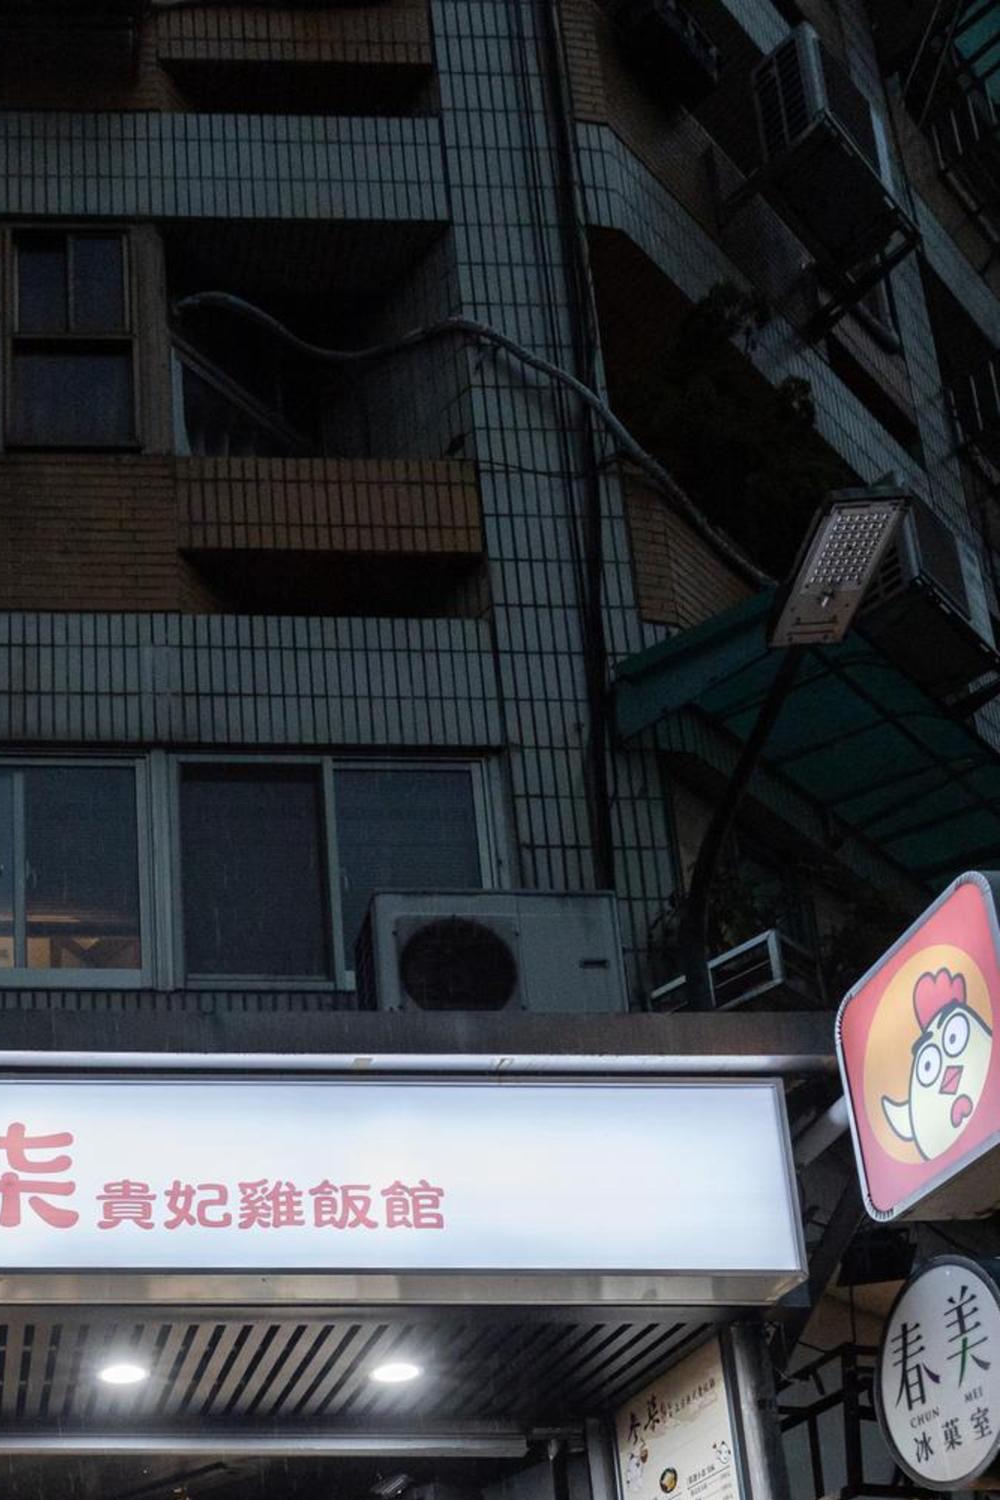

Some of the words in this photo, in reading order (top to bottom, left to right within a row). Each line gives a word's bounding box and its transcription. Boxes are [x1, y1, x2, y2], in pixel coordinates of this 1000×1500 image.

[96, 1178, 445, 1230] 貴妃雞飯館
[891, 1285, 991, 1412] 春美
[909, 1406, 941, 1429] CHUN
[963, 1386, 984, 1405] MEI
[913, 1406, 993, 1464] 冰菓室
